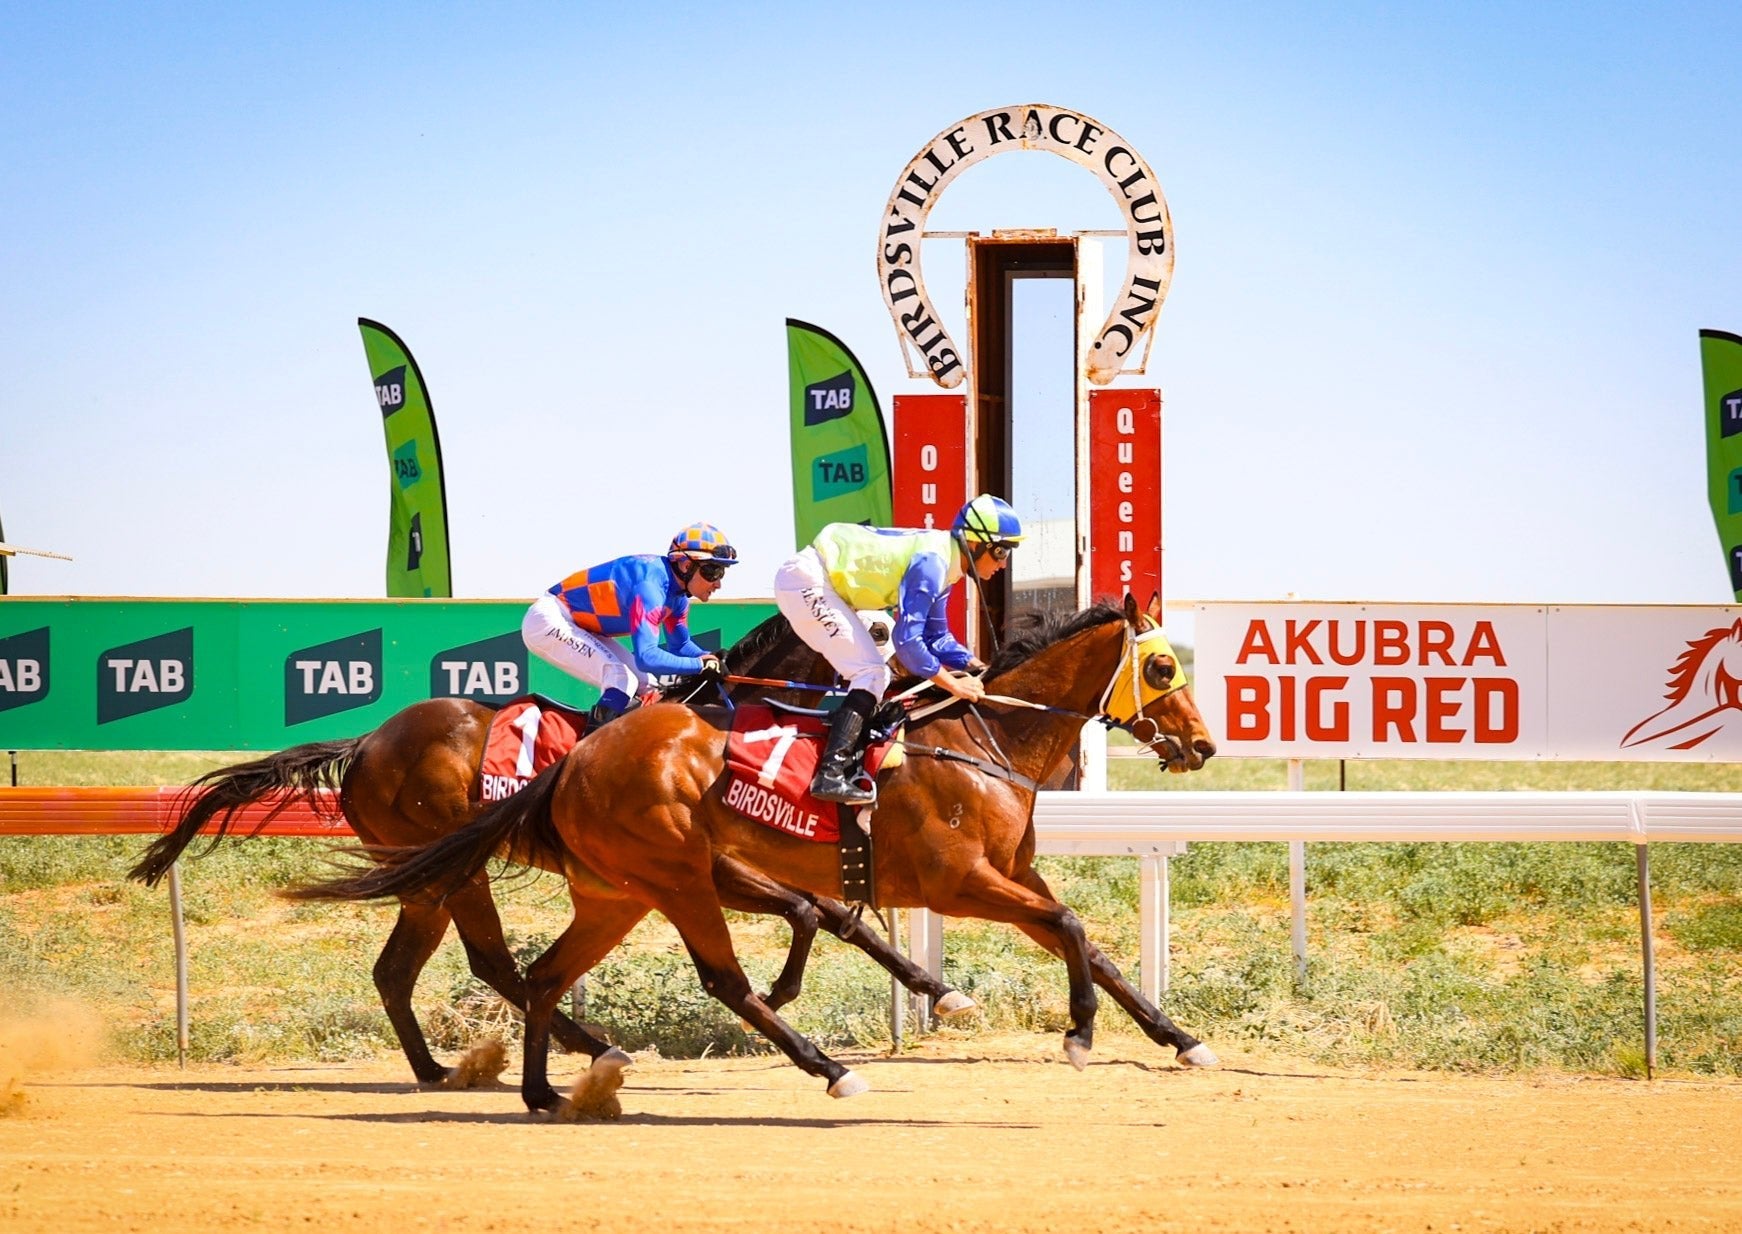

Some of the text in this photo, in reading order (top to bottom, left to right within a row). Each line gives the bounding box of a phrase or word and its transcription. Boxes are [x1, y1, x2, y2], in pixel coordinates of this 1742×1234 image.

[885, 109, 1166, 379] BIRDSVILLE RACE CLUB INC.
[810, 388, 850, 410] TAB
[819, 463, 865, 483] TAB
[1116, 407, 1135, 602] Queens
[1235, 619, 1507, 667] AKUBRA
[0, 658, 41, 692] AB
[108, 659, 185, 692] TAB
[296, 660, 374, 694] TAB
[441, 661, 520, 695] TAB
[1224, 675, 1519, 744] BIG RED
[513, 705, 542, 777] 1
[743, 724, 798, 789] 7
[728, 779, 819, 837] BIRDSVILLE
